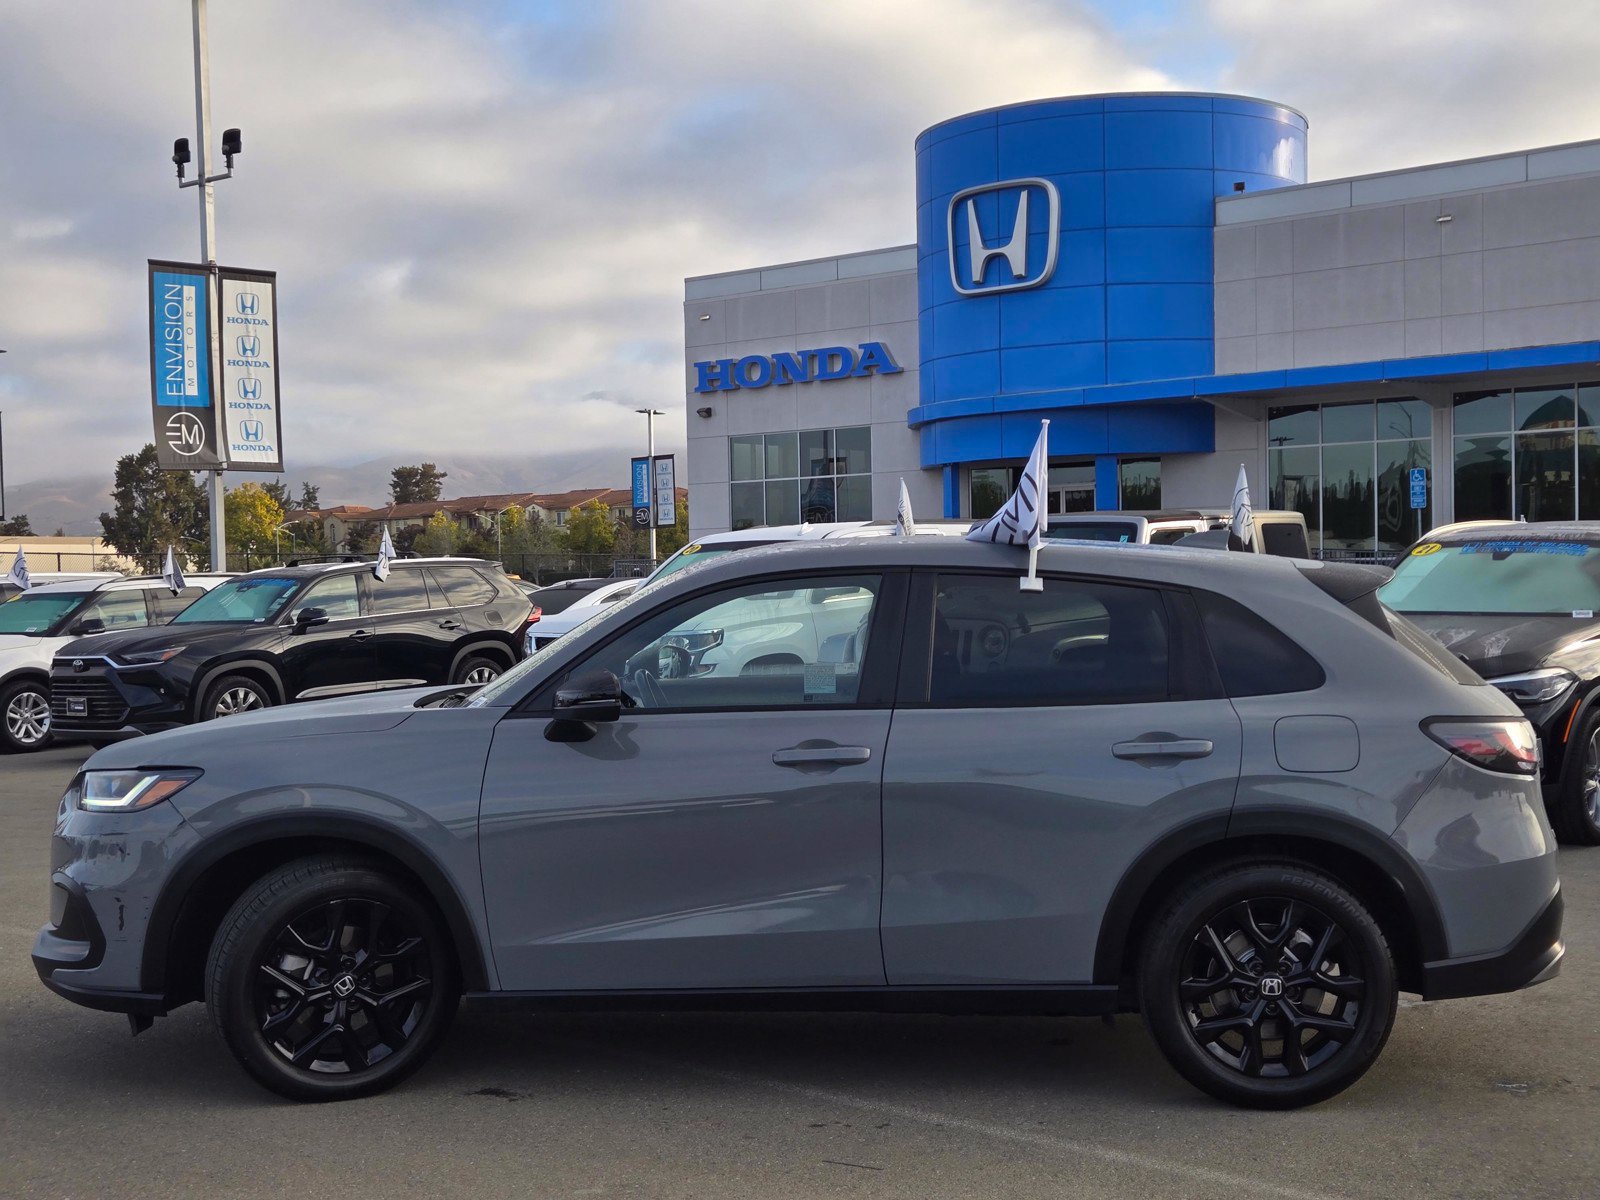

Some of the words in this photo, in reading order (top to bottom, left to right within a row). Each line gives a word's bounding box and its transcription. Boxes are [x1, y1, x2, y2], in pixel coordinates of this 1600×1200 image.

[226, 316, 270, 326] HONDA
[164, 283, 184, 396] ENVISION
[186, 295, 196, 387] MOTORS
[227, 359, 271, 369] HONDA
[693, 341, 902, 393] HONDA
[228, 401, 272, 411] HONDA
[232, 443, 274, 452] HONDA
